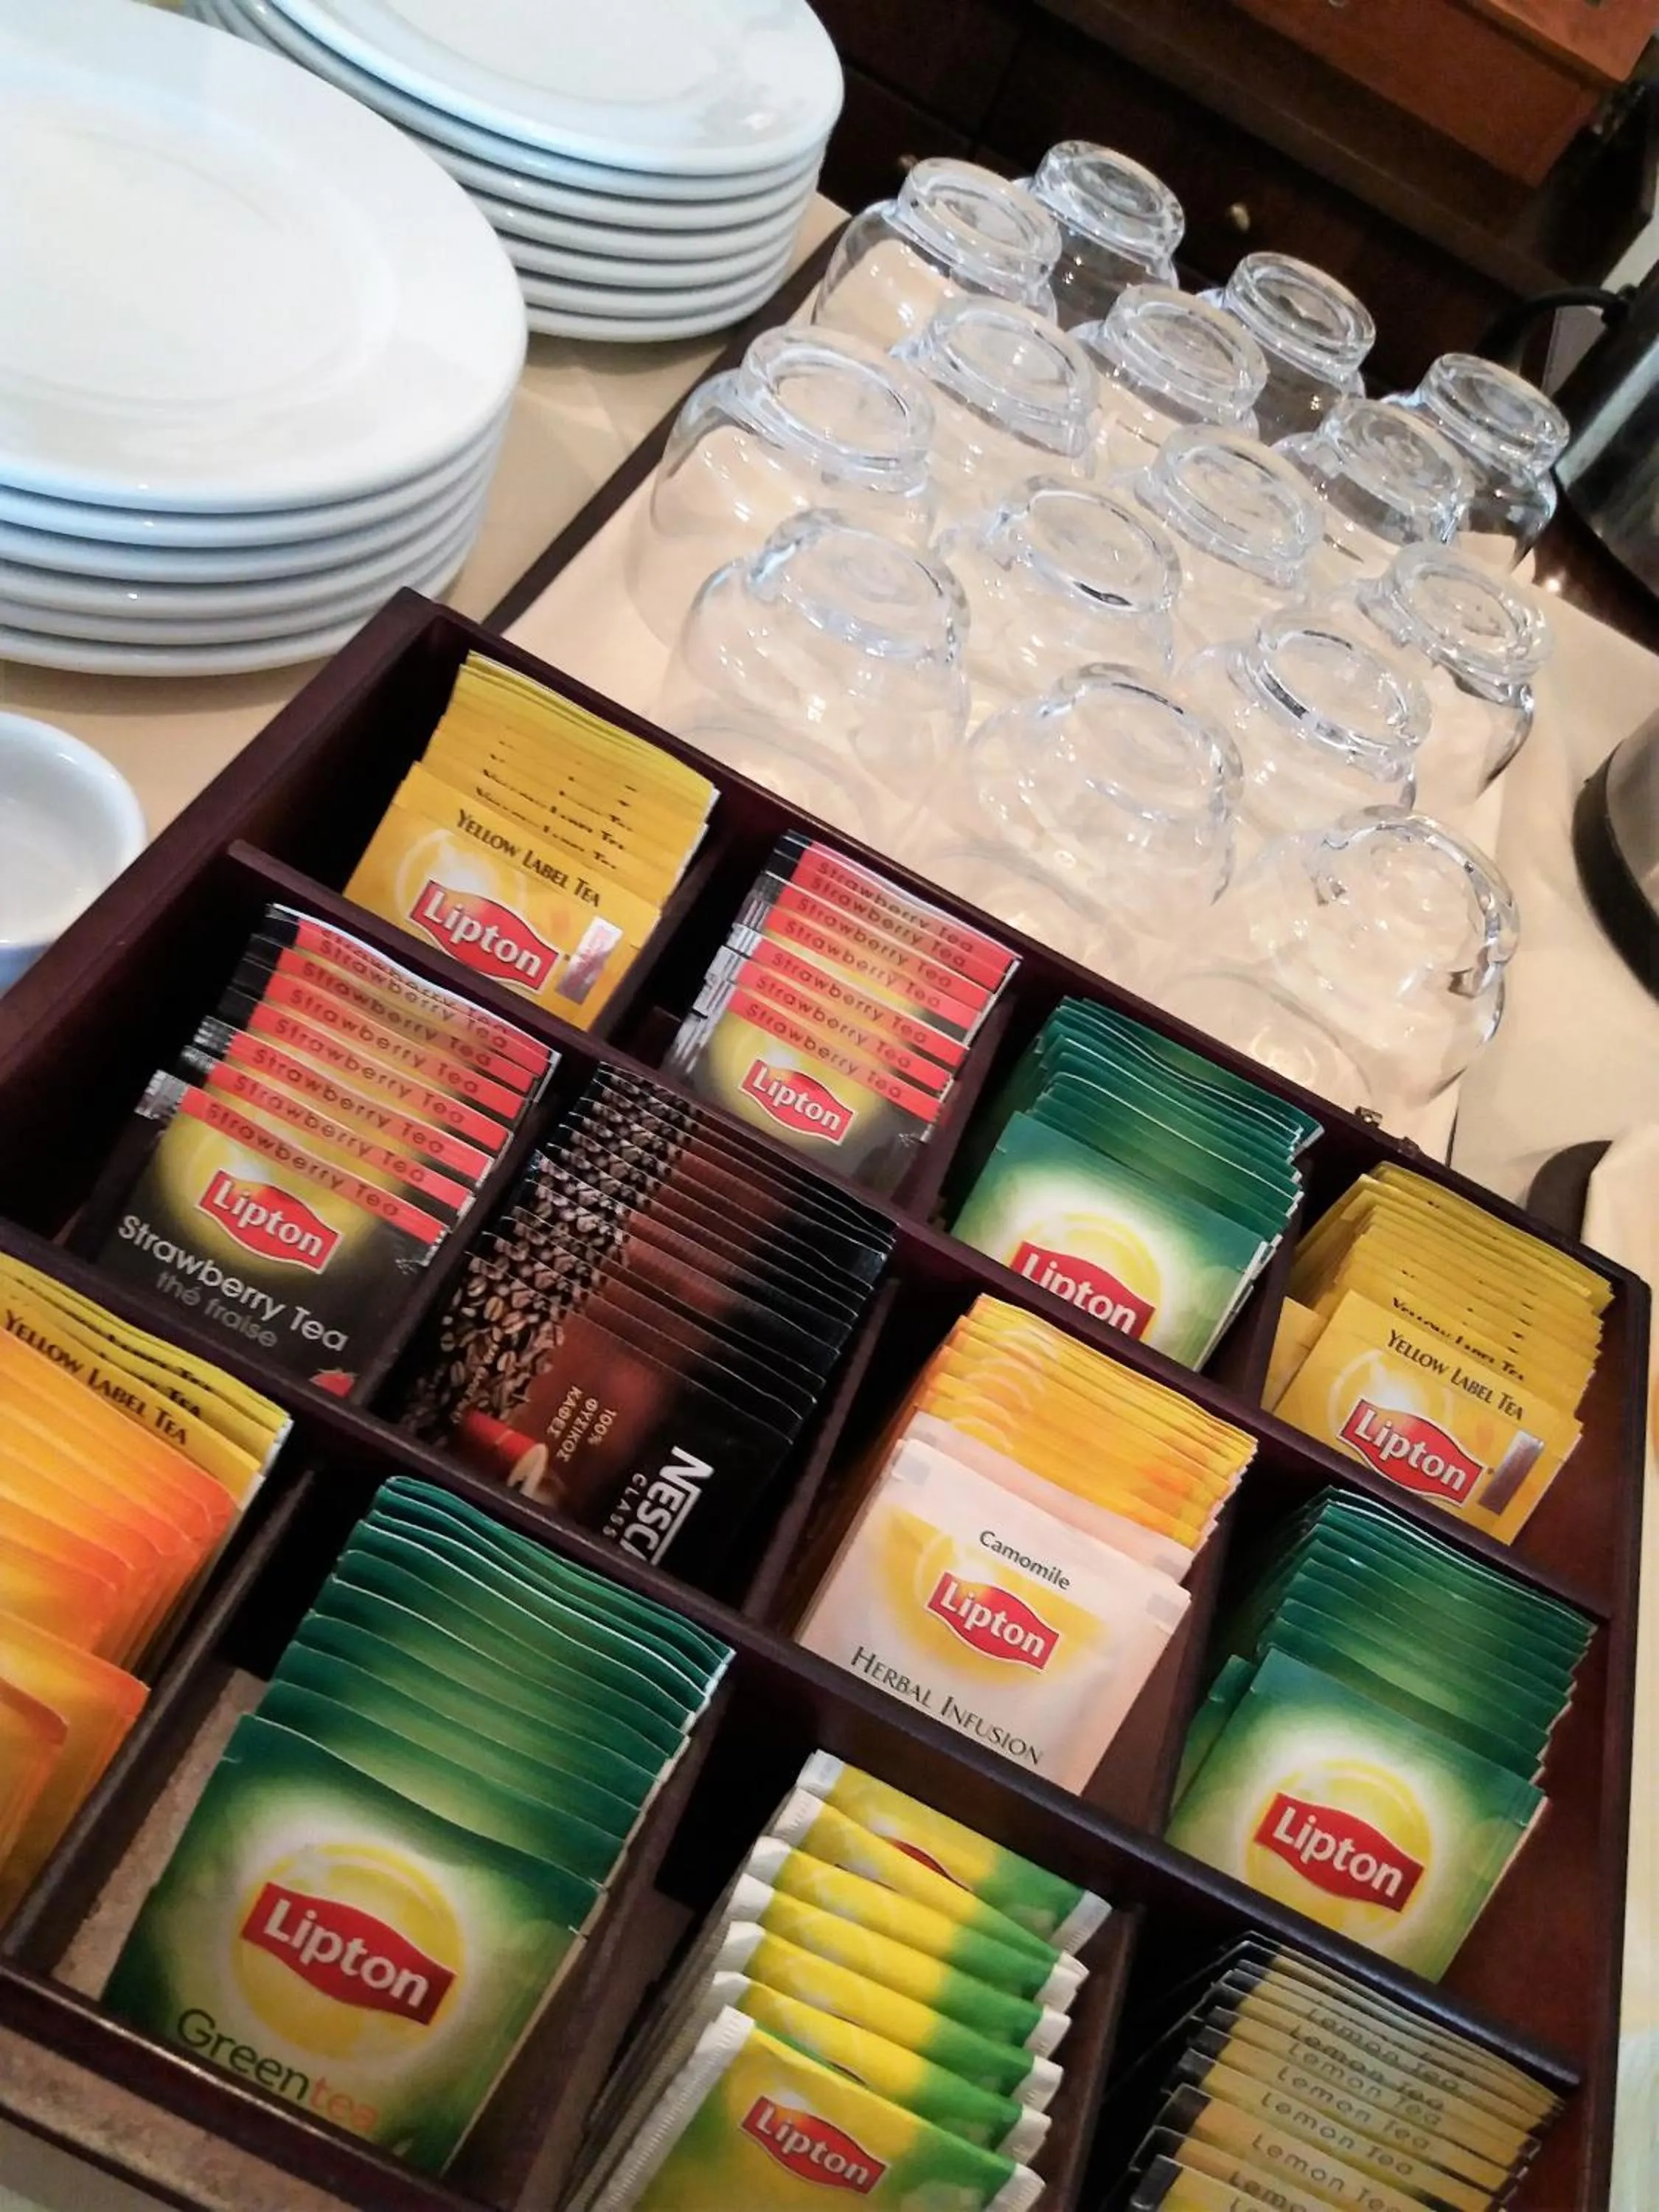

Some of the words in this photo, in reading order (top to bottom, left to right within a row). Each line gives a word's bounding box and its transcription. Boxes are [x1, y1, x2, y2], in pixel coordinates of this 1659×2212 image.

[455, 808, 519, 858] YELLOW
[522, 849, 569, 888] LABEL
[575, 877, 602, 908] TEA
[424, 891, 543, 979] Lipton
[785, 921, 898, 990] Strawberry
[904, 980, 942, 1008] Tea
[797, 897, 909, 966] Strawberry
[918, 961, 951, 987] Tea
[289, 988, 427, 1070] Strawberry
[435, 1060, 480, 1095] Tea
[301, 961, 438, 1042] Strawberry
[446, 1033, 493, 1068] Tea
[756, 976, 869, 1046] Strawberry
[875, 1041, 912, 1070] Tea
[771, 953, 883, 1022] Strawberry
[890, 1015, 928, 1045] Tea
[276, 1017, 413, 1100] Strawberry
[419, 1092, 465, 1125] Tea
[745, 1003, 860, 1074] Strawberry
[865, 1070, 902, 1099] Tea
[233, 1074, 370, 1159] Strawberry
[380, 1150, 426, 1185] Tea
[254, 1047, 394, 1130] Strawberry
[400, 1121, 446, 1156] Tea
[752, 1066, 841, 1132] Lipton
[206, 1101, 344, 1191] Strawberry
[352, 1183, 400, 1218] Tea
[213, 1180, 324, 1259] Lipton
[119, 1214, 287, 1322] Strawberry
[293, 1301, 348, 1353] Tea
[156, 1271, 201, 1307] thé
[204, 1299, 278, 1348] fraise
[4, 1309, 84, 1374] YELLOW
[88, 1368, 148, 1417] LABEL
[156, 1406, 189, 1446] TEA
[1387, 1329, 1450, 1375] YELLOW
[1450, 1367, 1495, 1404] LABEL
[1497, 1391, 1523, 1422] TEA
[556, 1397, 599, 1462] ΦΥΣΙΚΟΣ
[586, 1408, 618, 1446] 100%
[1354, 1409, 1467, 1491] Lipton
[978, 1529, 1071, 1592] Camomile
[940, 1580, 1046, 1659] Lipton
[849, 1646, 932, 1710] HERBAL
[940, 1695, 1044, 1766] INFUSION
[1271, 1806, 1404, 1898] Lipton
[262, 1897, 429, 2008] Lipton
[755, 2104, 871, 2188] Lipton
[1261, 2092, 1355, 2150] Lemon
[1366, 2145, 1414, 2176] Tea
[1277, 2065, 1372, 2123] Lemon
[1382, 2119, 1430, 2150] Tea
[1251, 2133, 1346, 2192] Lemon
